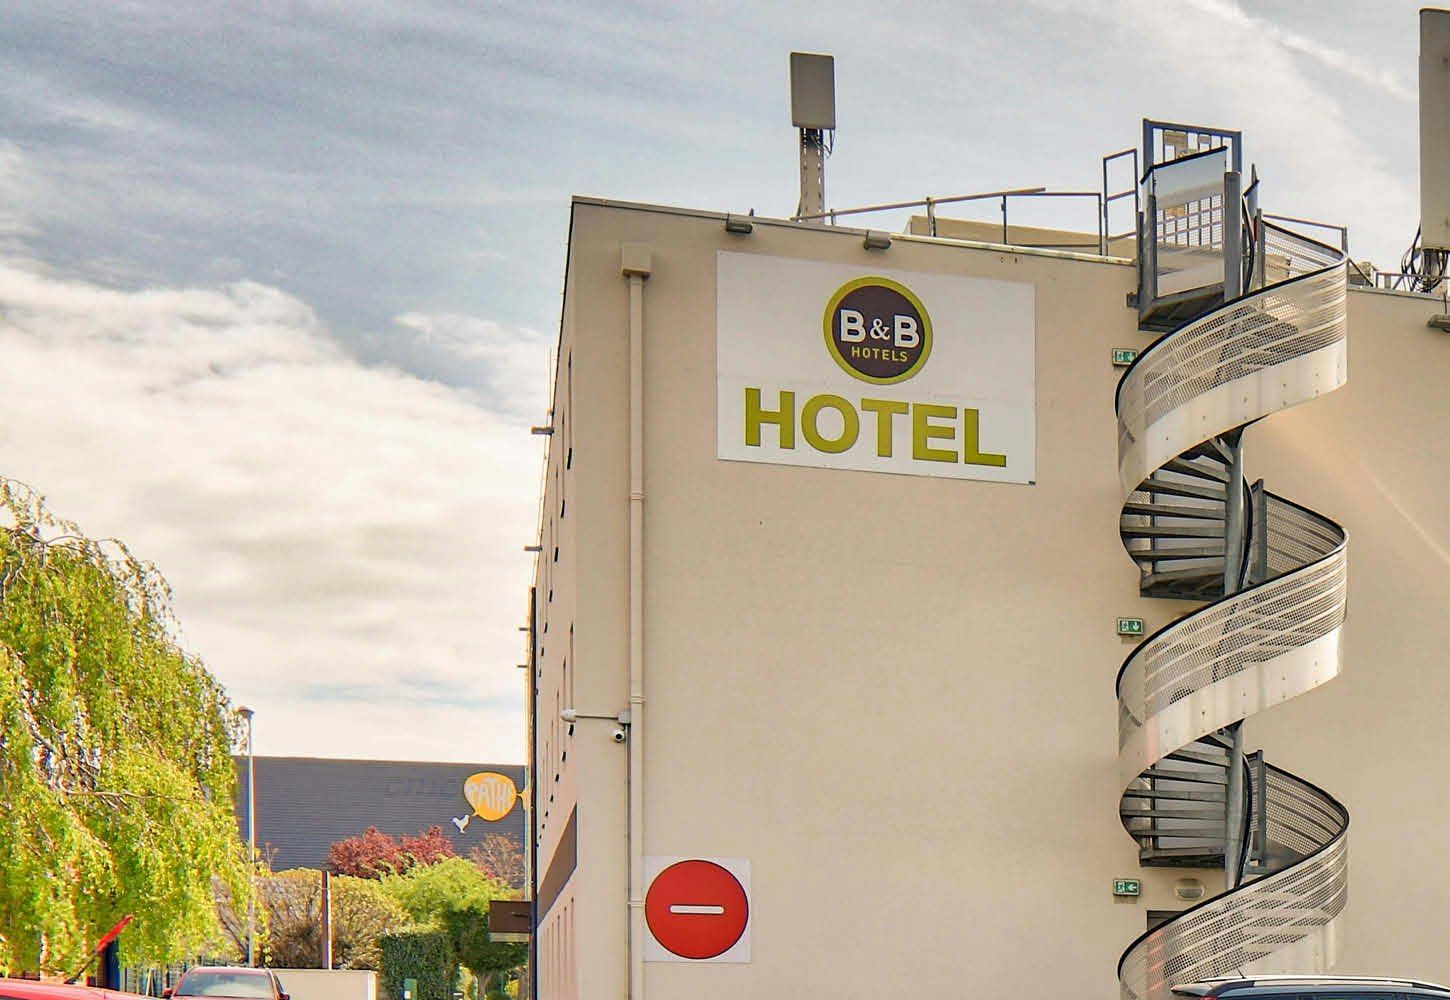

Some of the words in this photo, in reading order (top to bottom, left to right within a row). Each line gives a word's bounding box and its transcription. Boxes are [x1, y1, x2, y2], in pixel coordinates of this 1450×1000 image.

[840, 309, 920, 348] B&B
[851, 346, 909, 362] HOTELS
[744, 386, 1007, 468] HOTEL
